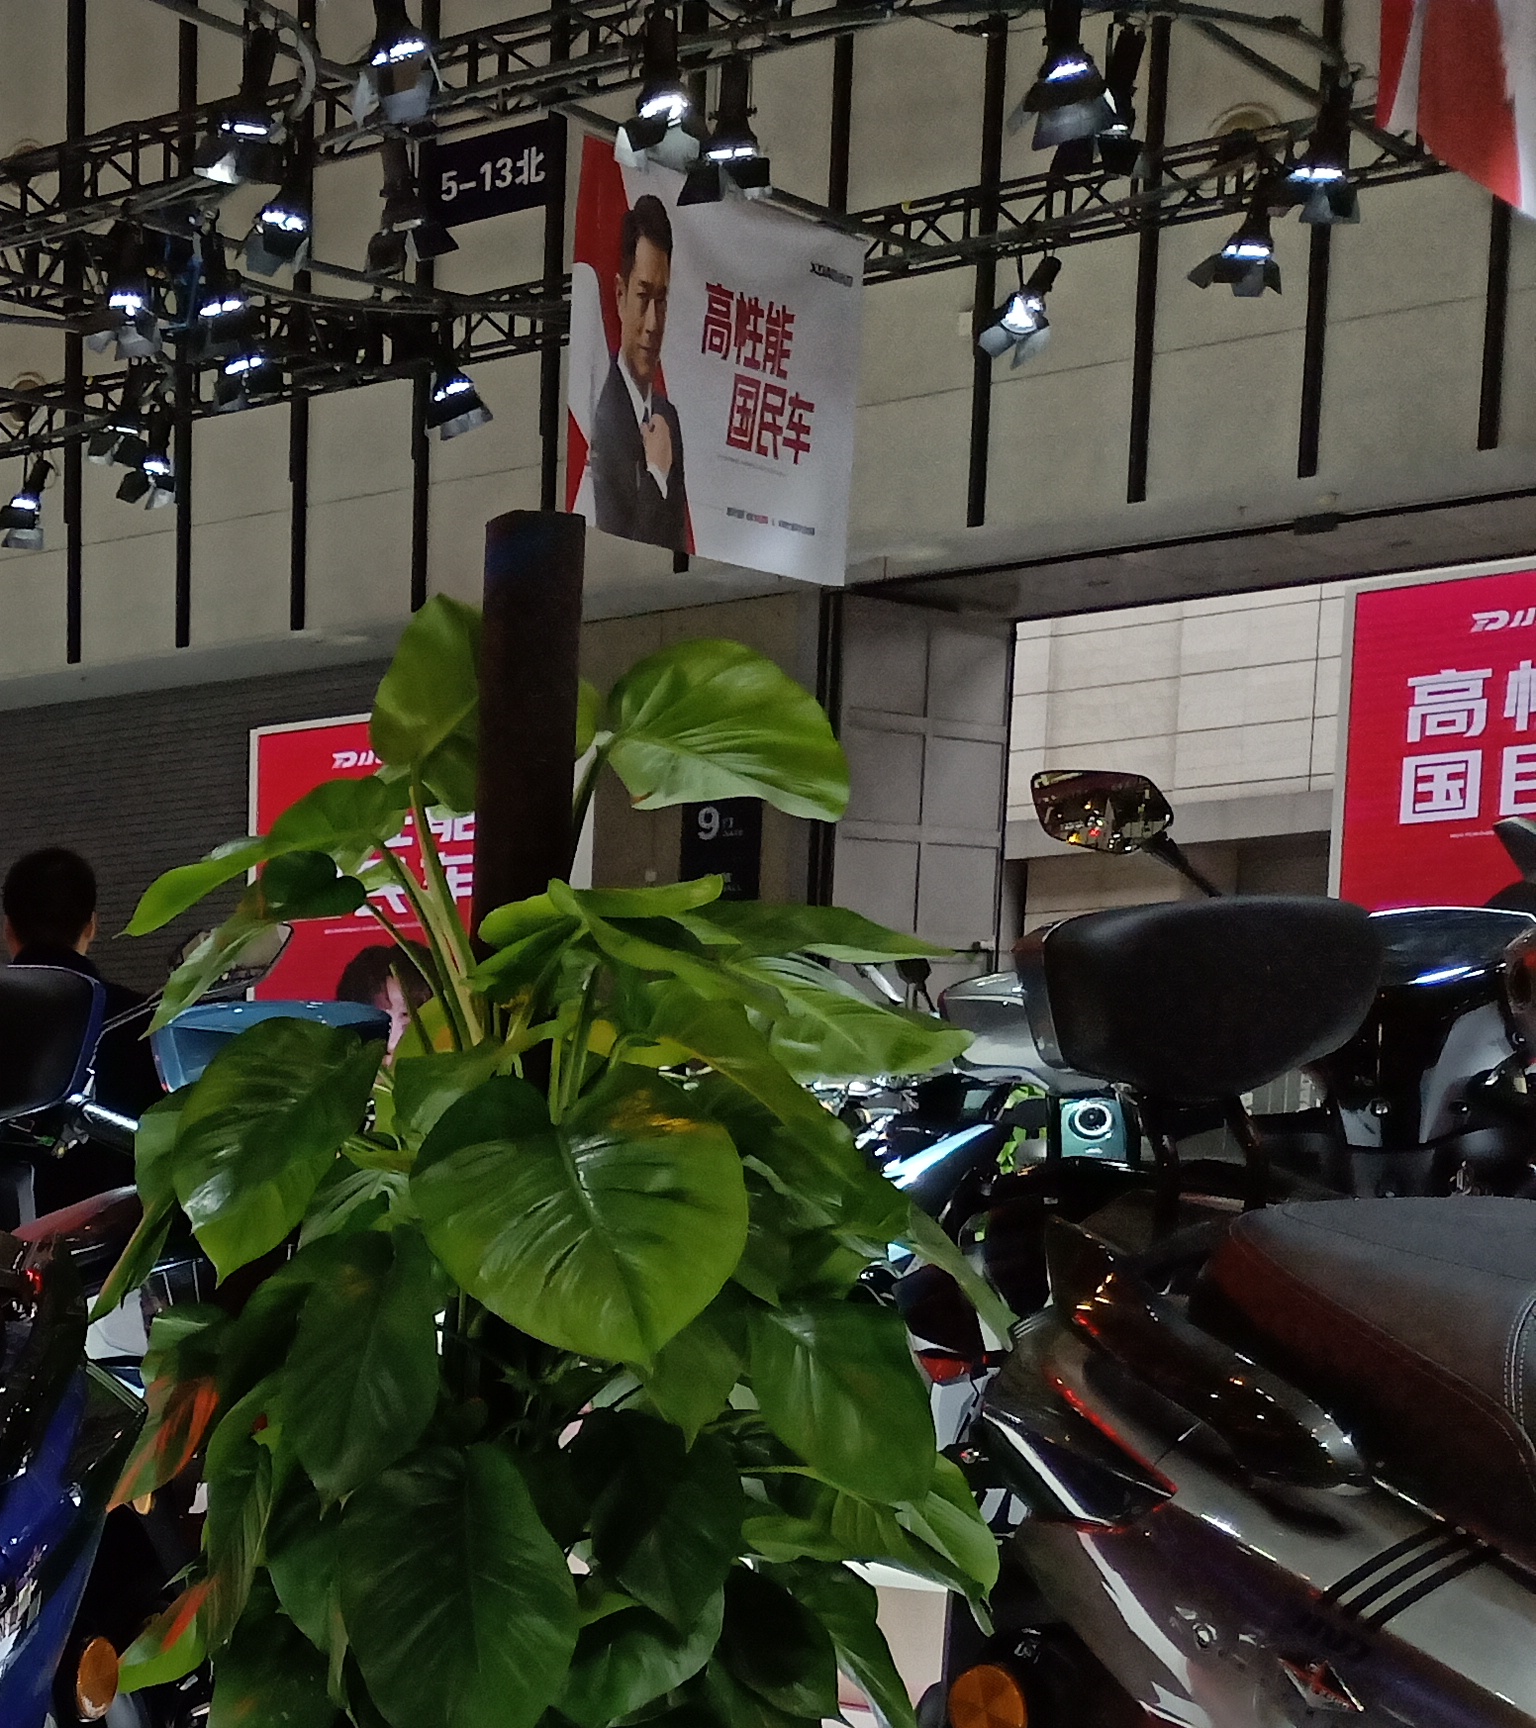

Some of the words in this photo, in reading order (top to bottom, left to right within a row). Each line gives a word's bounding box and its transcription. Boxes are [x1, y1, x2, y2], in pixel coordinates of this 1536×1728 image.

[441, 146, 546, 201] 5-13北
[701, 281, 796, 380] 高性能
[726, 372, 815, 465] 国民车
[698, 806, 720, 840] 9
